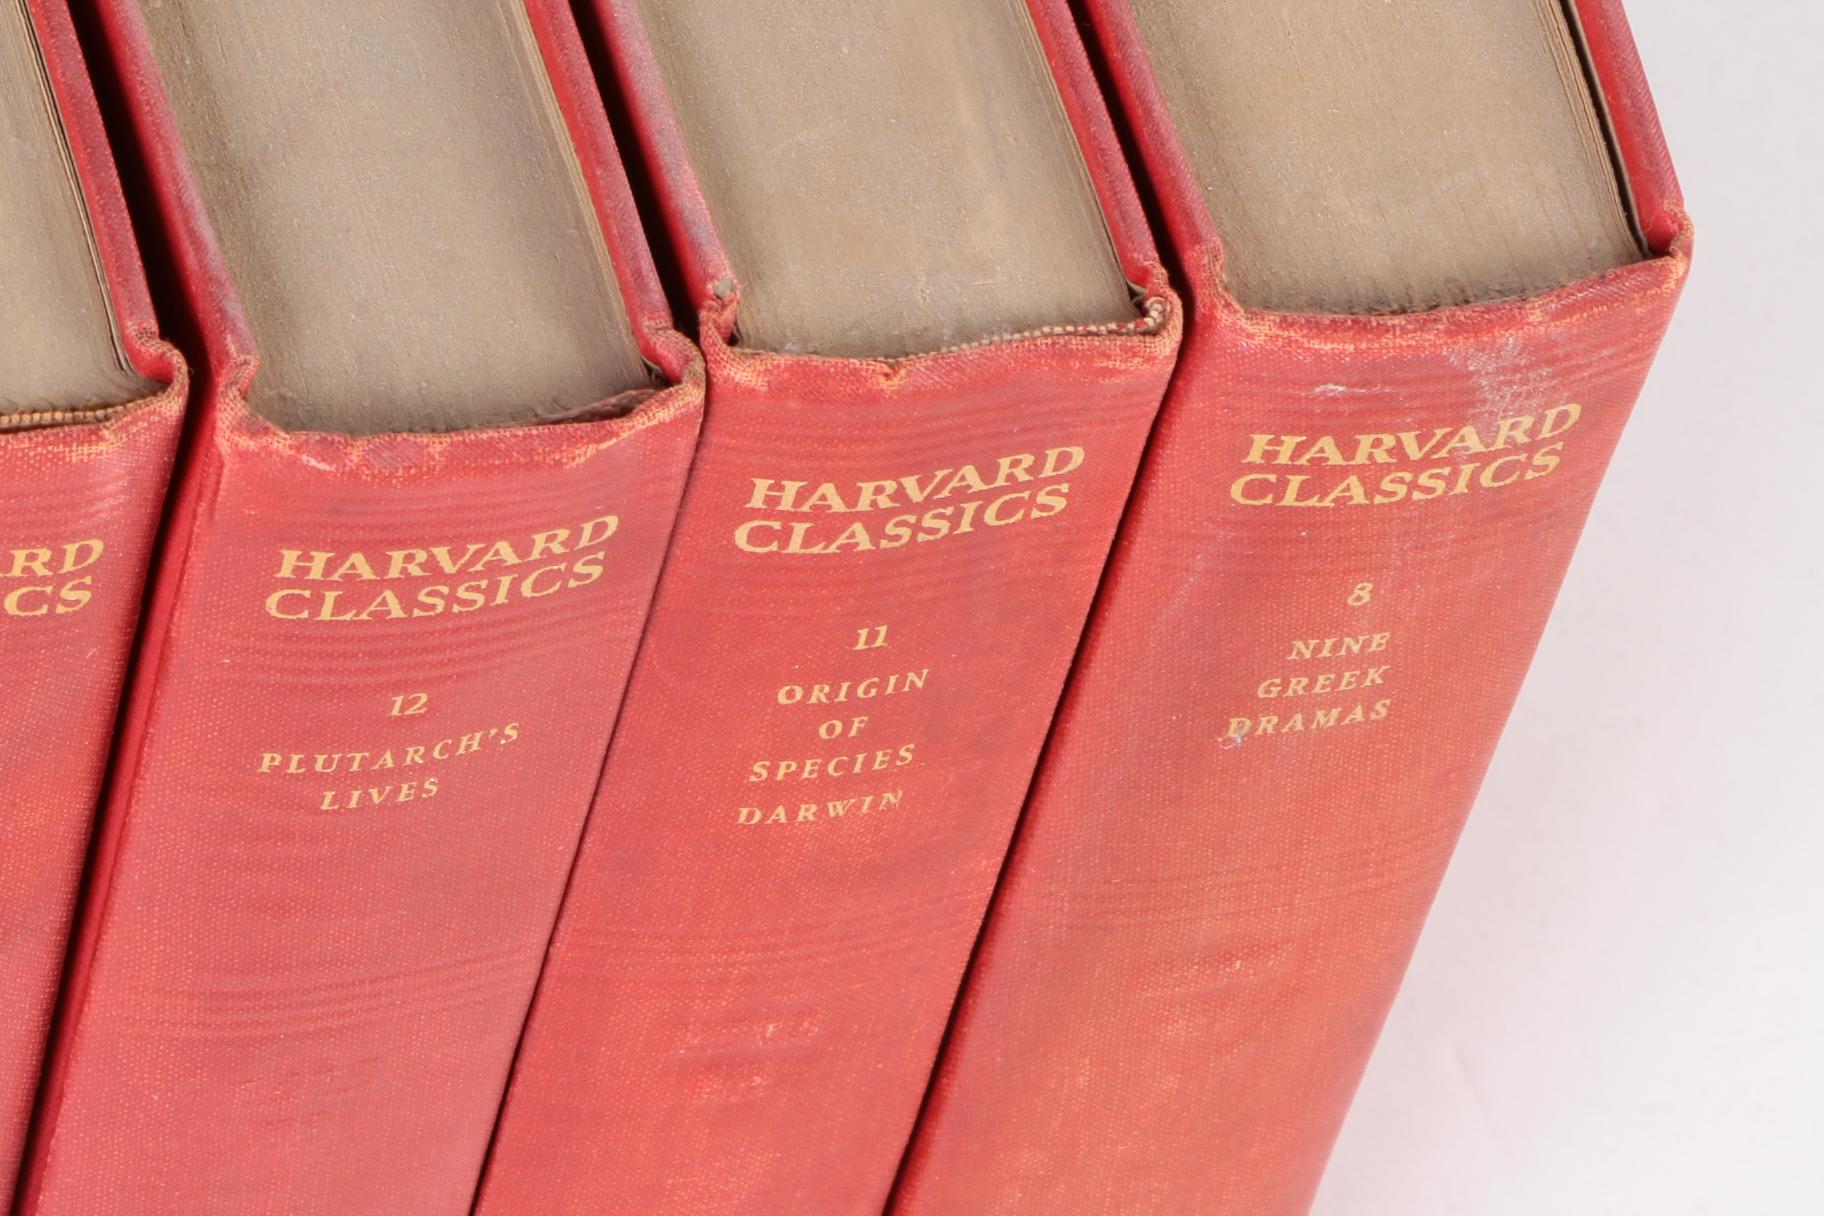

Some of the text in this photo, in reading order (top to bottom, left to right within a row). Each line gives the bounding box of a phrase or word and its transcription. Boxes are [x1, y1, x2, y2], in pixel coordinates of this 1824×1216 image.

[1241, 403, 1582, 464] HARVARD
[745, 446, 1085, 512] HARVARD
[1230, 442, 1565, 506] CLASSICS
[734, 483, 1070, 554] CLASSICS
[275, 515, 619, 581] HARVARD
[266, 551, 605, 621] CLASSICS
[1347, 582, 1372, 606] 8
[855, 625, 888, 650] 11
[1286, 632, 1390, 660] NINE
[777, 669, 930, 705] ORIGIN
[1257, 666, 1390, 699] GREEK
[388, 693, 428, 716] 12
[1227, 699, 1390, 739] DRAMAS
[818, 716, 868, 740] OF
[749, 744, 916, 782] SPECIES
[320, 778, 439, 810] LIVES
[737, 790, 904, 825] DARWIN
